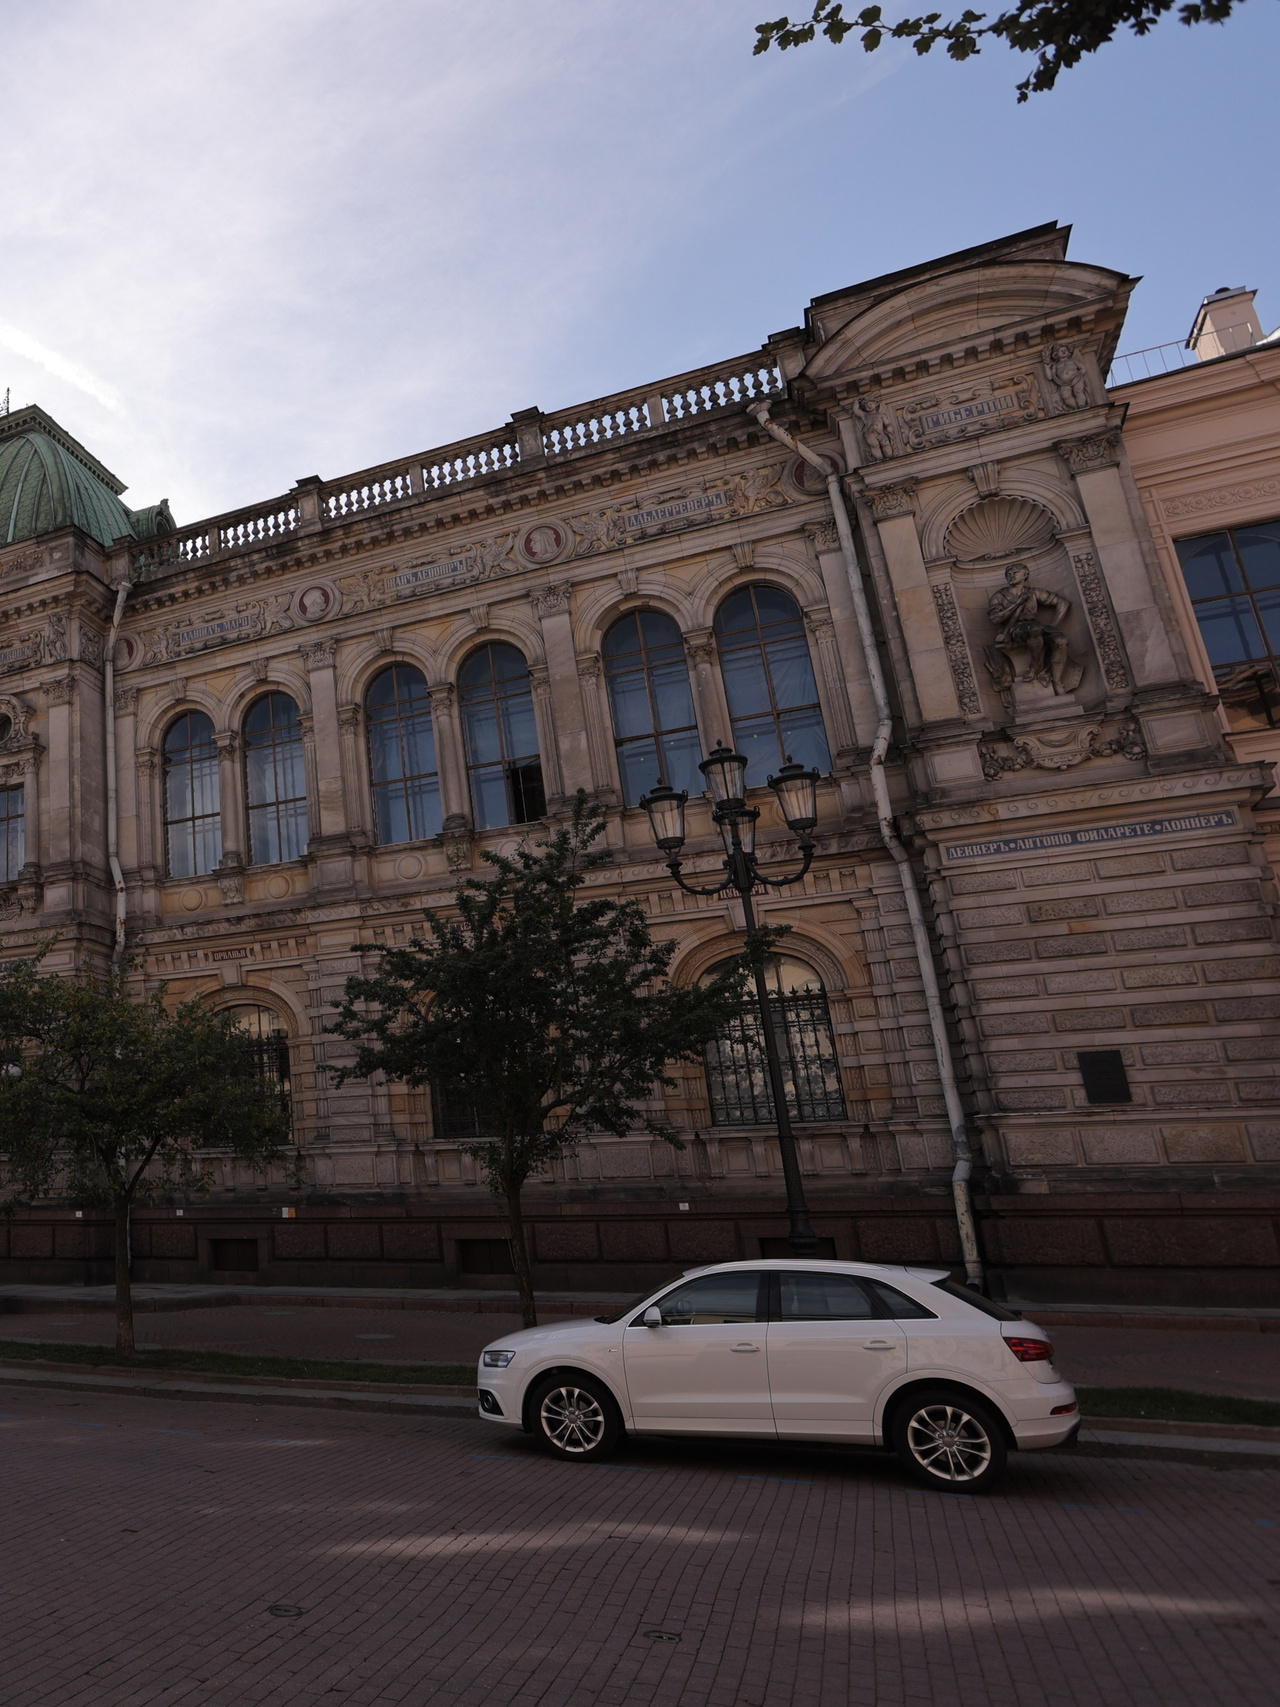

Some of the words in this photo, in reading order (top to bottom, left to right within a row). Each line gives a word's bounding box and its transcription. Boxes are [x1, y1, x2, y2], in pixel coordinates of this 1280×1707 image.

[949, 841, 1009, 859] ДЕККЕРЪ
[1077, 822, 1153, 842] ФИЛАРЕТЕ
[1162, 813, 1233, 833] ДОННЕРЪ
[719, 884, 766, 899] ЦУКРИ
